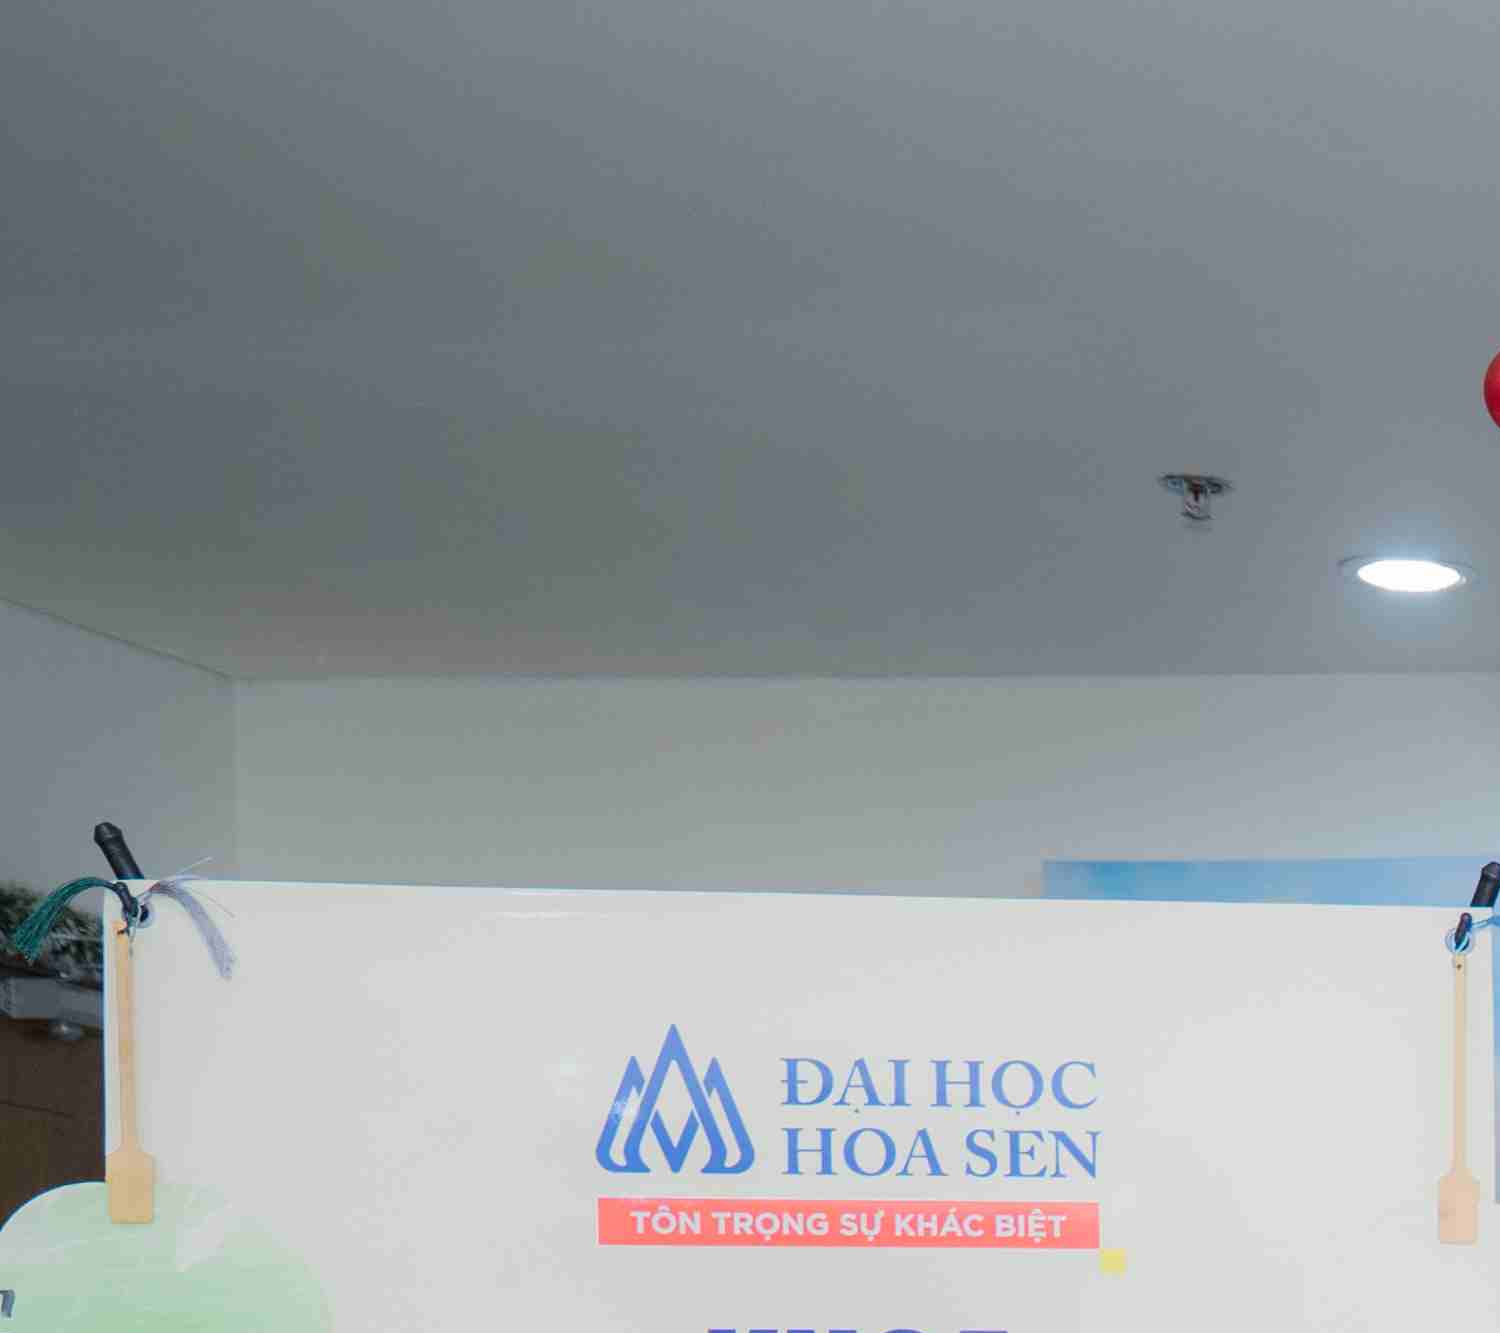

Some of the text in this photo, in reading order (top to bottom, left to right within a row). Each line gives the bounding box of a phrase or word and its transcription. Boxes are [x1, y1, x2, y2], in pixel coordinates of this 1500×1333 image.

[781, 1058, 1096, 1115] ĐẠI HỌC
[782, 1128, 1100, 1178] HOA SEN
[630, 1206, 1067, 1242] TÔN TRỌNG SỰ KHÁC BIỆT
